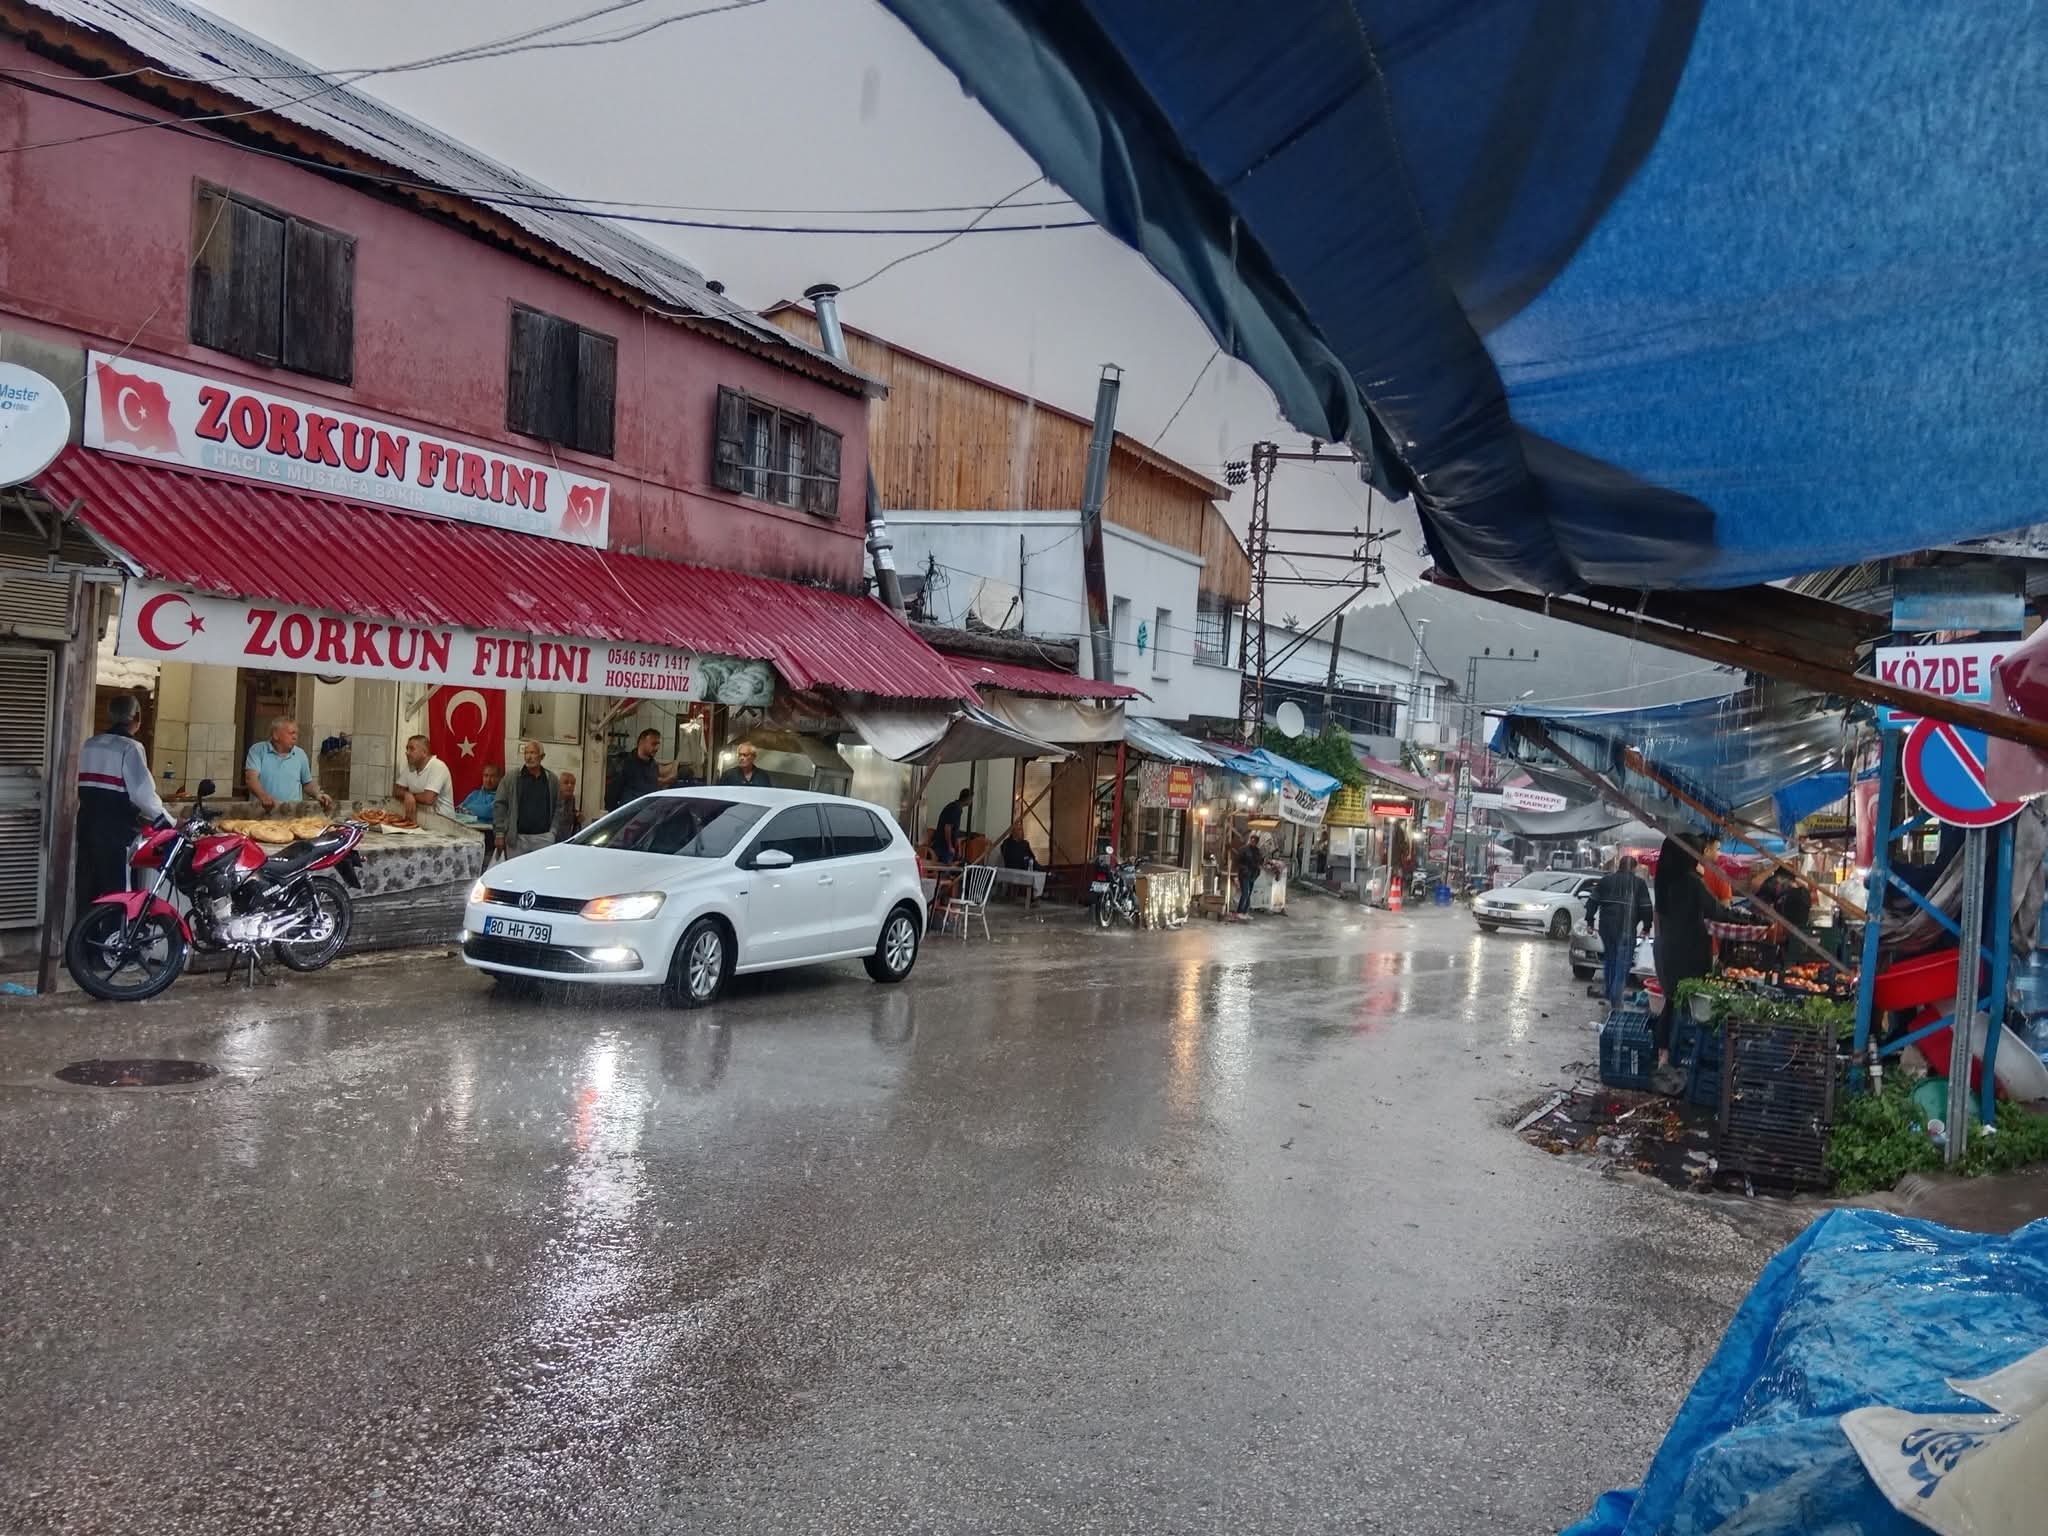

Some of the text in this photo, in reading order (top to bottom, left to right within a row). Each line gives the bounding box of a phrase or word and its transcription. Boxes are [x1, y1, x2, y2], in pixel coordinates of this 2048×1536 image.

[195, 385, 548, 513] ZORKUN FIRINI
[213, 447, 425, 506] HACI & MUSTAFA BAKIR
[243, 607, 591, 684] ZORKUN FIRINI
[607, 648, 690, 671] 0546 547 1417
[605, 669, 690, 693] HOŞGELDİNİZ
[1881, 650, 1980, 695] KÖZDE
[490, 919, 504, 934] 80
[508, 922, 525, 937] HH
[528, 925, 549, 942] 799
